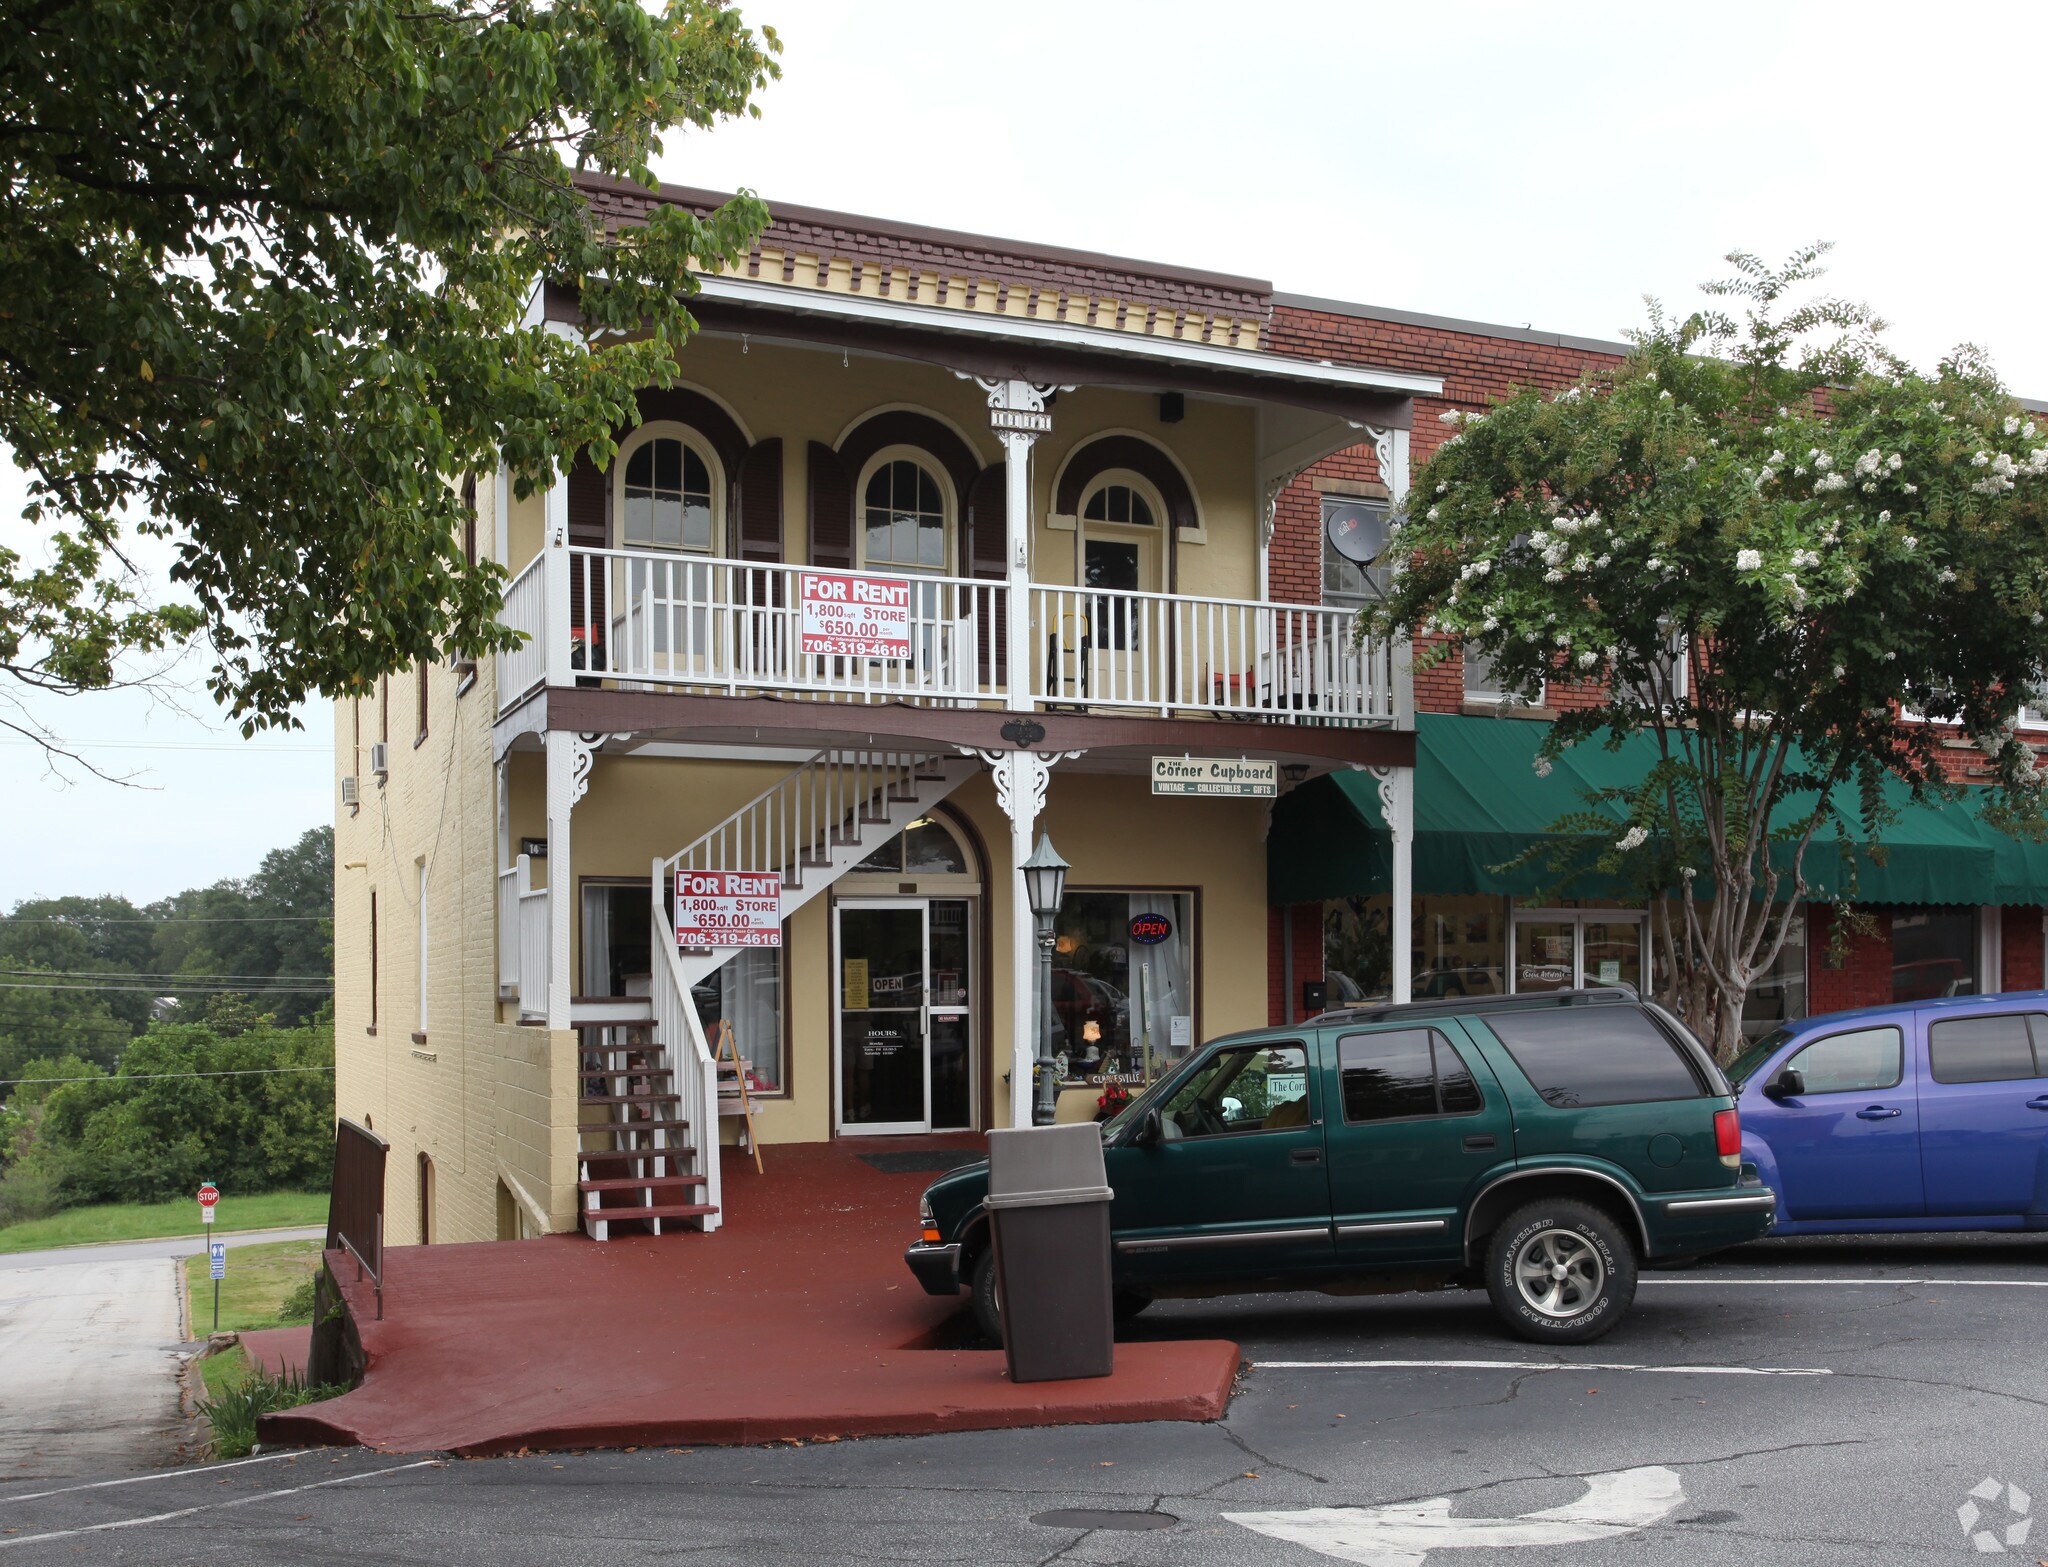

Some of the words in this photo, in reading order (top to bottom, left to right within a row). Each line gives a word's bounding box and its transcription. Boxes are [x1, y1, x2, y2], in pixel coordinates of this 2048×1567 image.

[804, 576, 847, 600] FOR
[853, 580, 908, 605] RENT
[864, 607, 906, 622] STORE
[820, 620, 878, 637] $650.00
[804, 640, 908, 657] 706-319-4616
[1156, 762, 1203, 777] Corner
[1210, 764, 1273, 782] Cupboard
[1158, 783, 1185, 792] VINTAGE
[1198, 784, 1241, 793] COLLECTIBLES
[1253, 785, 1271, 794] GIFTS
[679, 874, 720, 894] FOR
[725, 875, 778, 895] RENT
[736, 899, 776, 912] STORE
[693, 914, 750, 927] $650.00
[1132, 923, 1167, 935] OPEN
[678, 933, 779, 944] 706-319-4616
[875, 978, 902, 990] OPEN
[1273, 1081, 1287, 1091] The
[200, 1193, 218, 1201] STOP
[1503, 1219, 1554, 1287] WRANGLER
[1577, 1224, 1615, 1275] RADIAL
